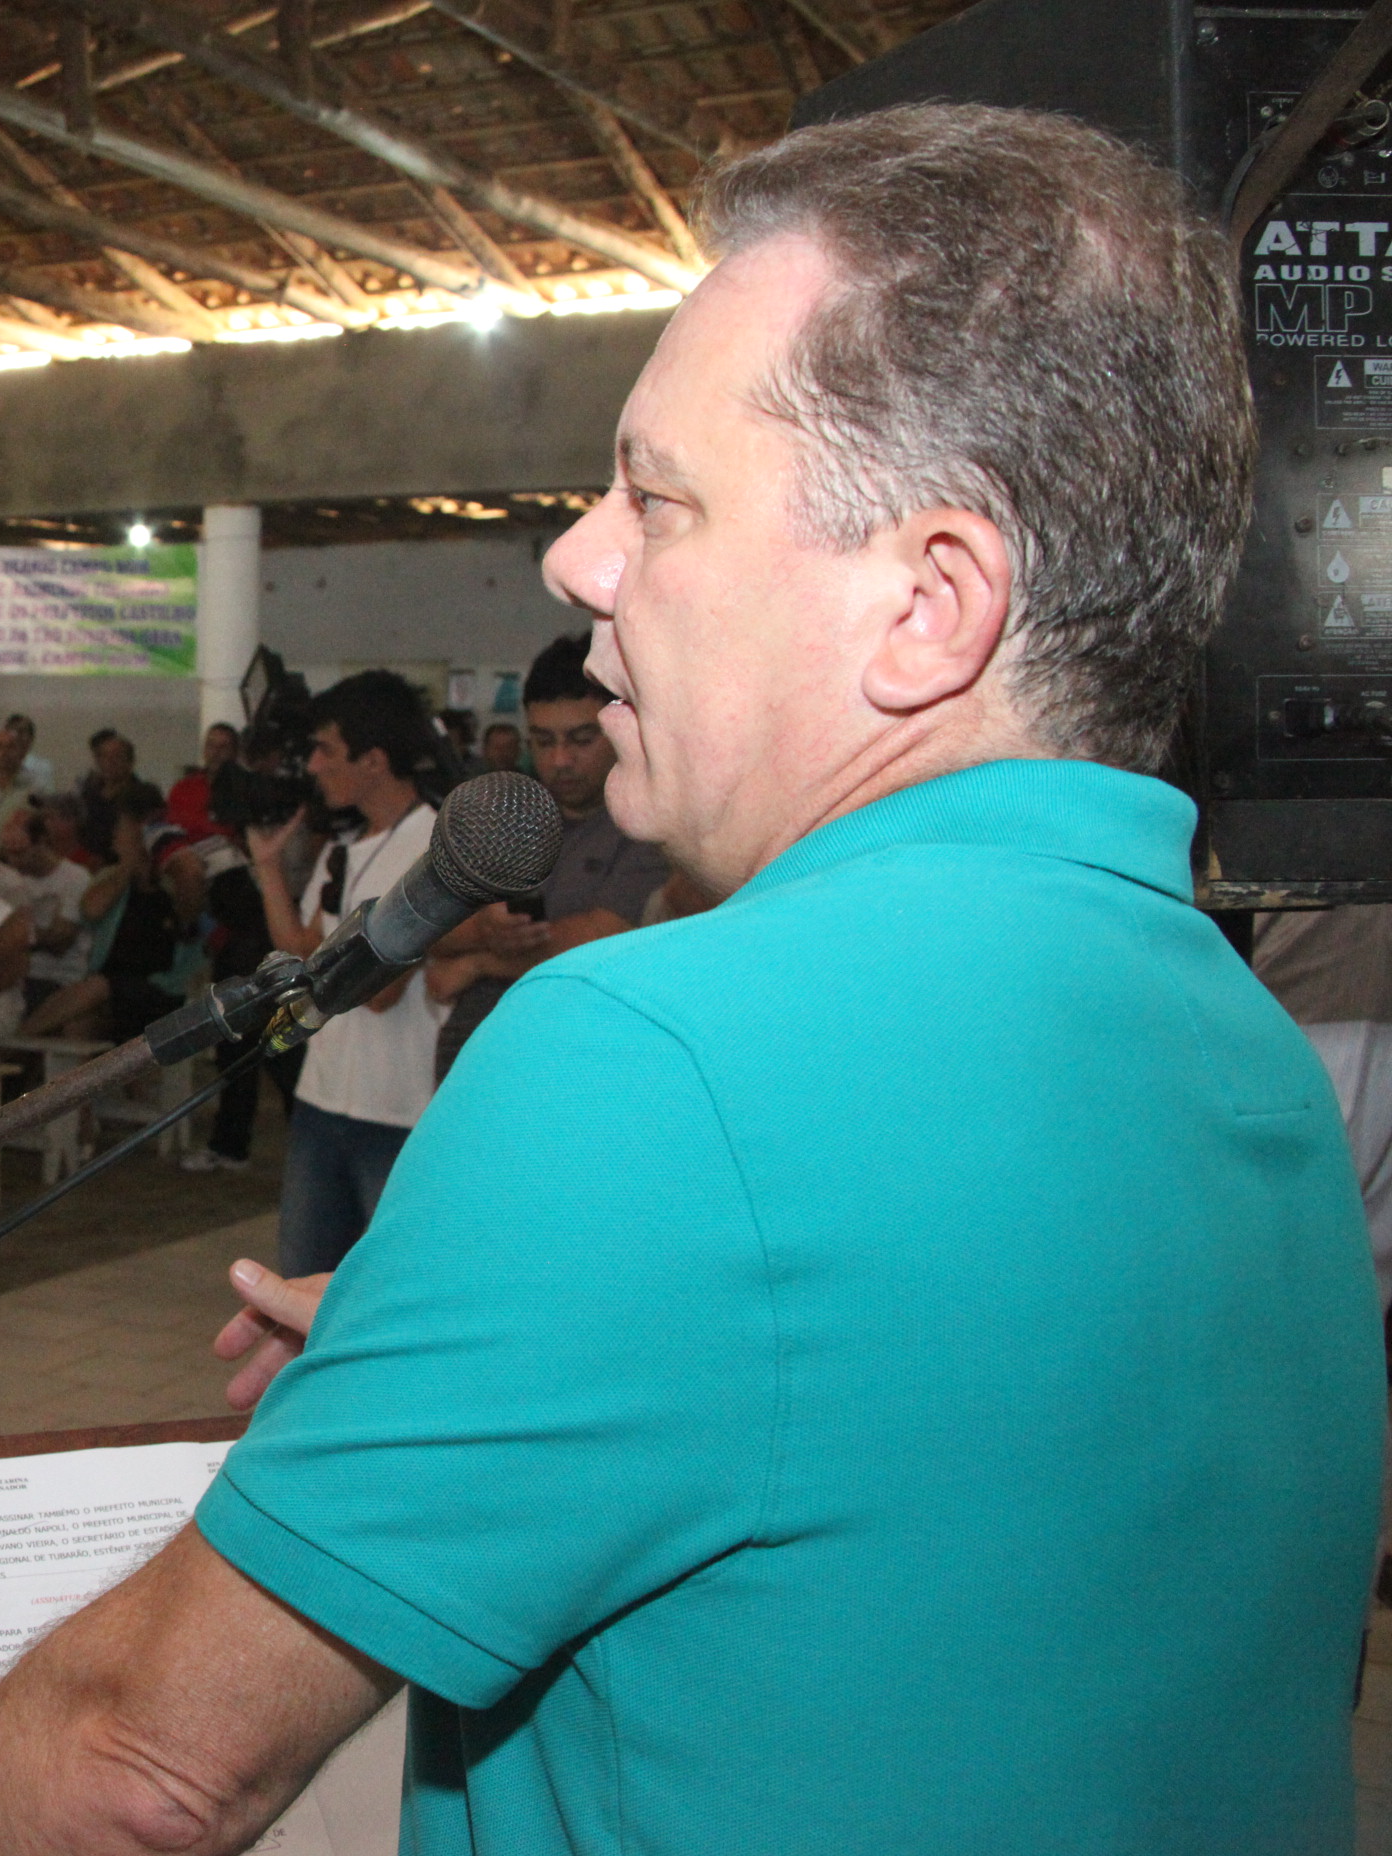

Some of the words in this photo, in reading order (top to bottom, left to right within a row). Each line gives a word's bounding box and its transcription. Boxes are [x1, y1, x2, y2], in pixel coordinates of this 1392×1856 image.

[1253, 221, 1392, 257] ATT
[1253, 264, 1370, 281] AUDIO
[1255, 283, 1373, 332] MP
[1256, 333, 1365, 347] POWERED
[94, 1502, 135, 1513] PREFEITO
[138, 1497, 184, 1508] MUNICIPAL
[34, 1523, 69, 1534] NAPOLI,
[72, 1522, 79, 1530] O
[82, 1518, 124, 1528] PREFEITO
[127, 1512, 173, 1523] MUNICIPAL
[26, 1538, 58, 1549] VIEIRA,
[61, 1537, 69, 1545] O
[72, 1531, 125, 1543] SECRETÁRIO
[128, 1529, 140, 1537] DE
[34, 1554, 46, 1562] DE
[49, 1548, 91, 1561] TUBARÃO,
[0, 1628, 22, 1637] PARA
